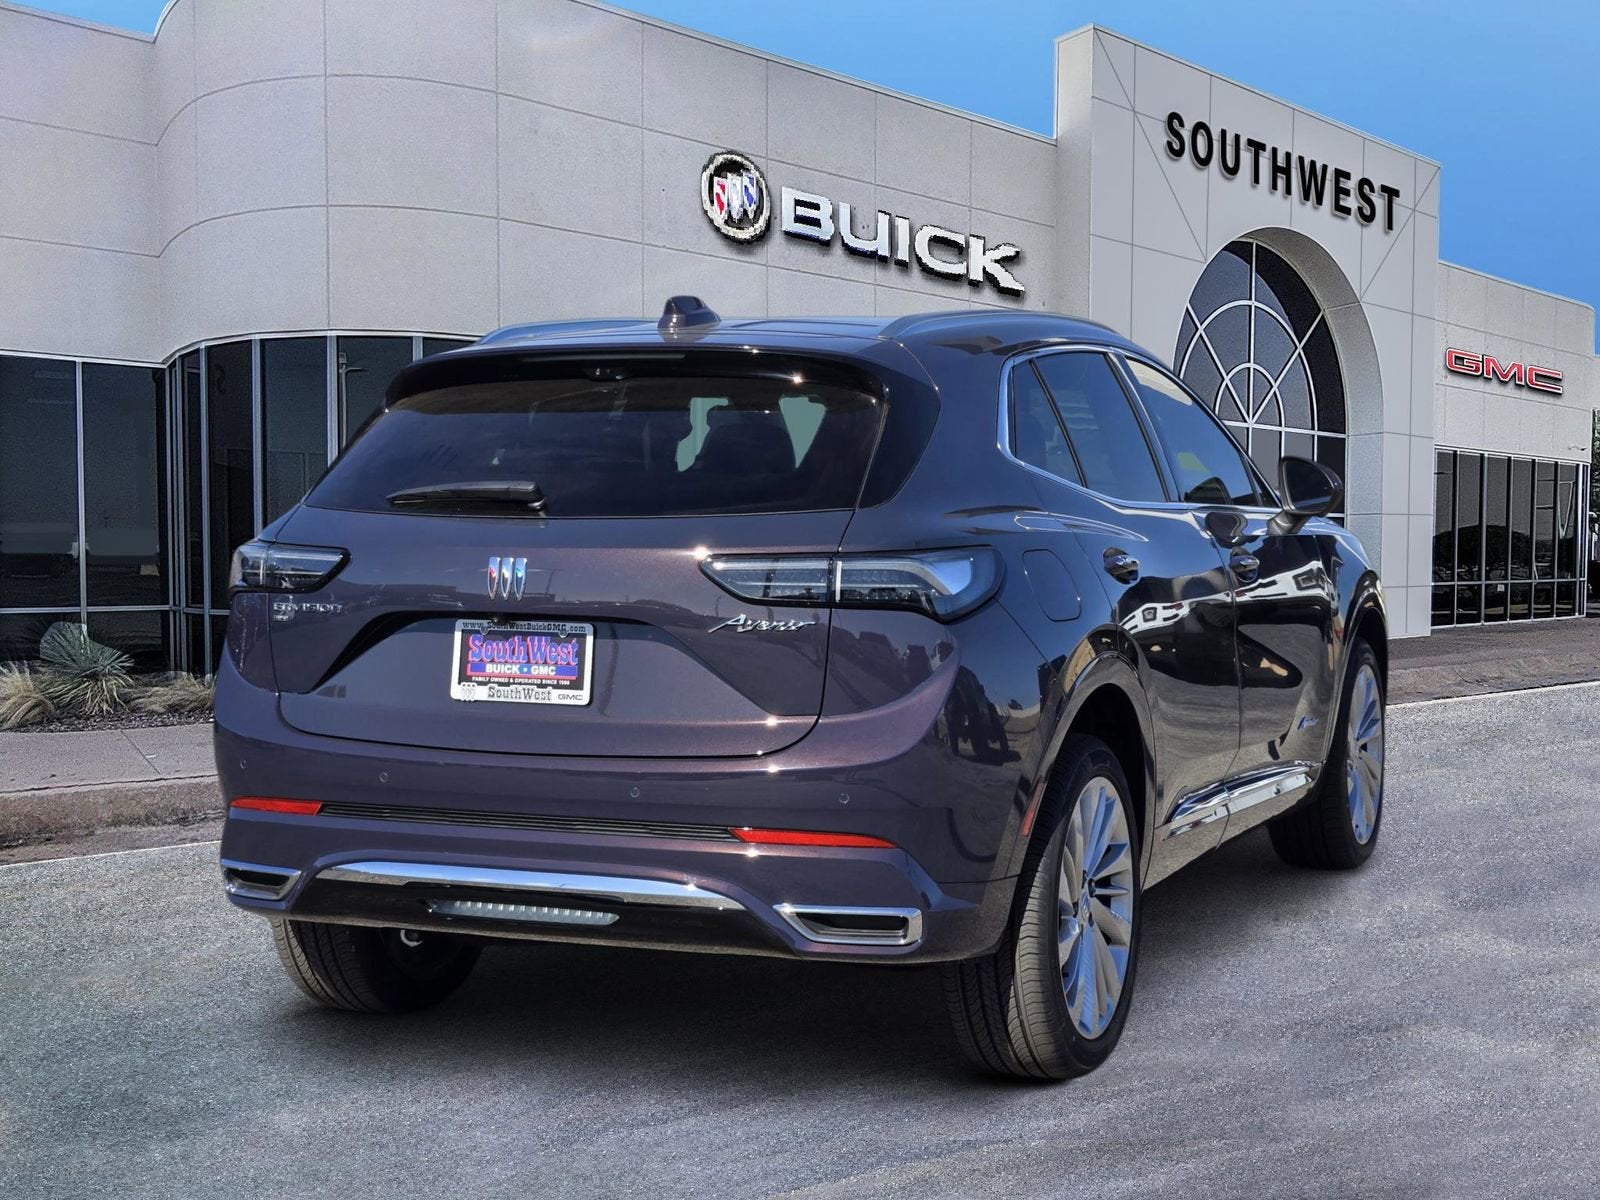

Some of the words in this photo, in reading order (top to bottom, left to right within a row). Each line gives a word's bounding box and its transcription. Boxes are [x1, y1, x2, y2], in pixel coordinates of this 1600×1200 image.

[1166, 111, 1400, 231] SOUTHWEST
[781, 187, 1026, 296] BUICK
[1446, 347, 1563, 395] GMC
[707, 613, 816, 633] Avenir
[468, 634, 580, 666] SouthWest
[485, 664, 520, 675] BUICK
[530, 666, 557, 676] GMC
[487, 686, 552, 701] SouthWest
[558, 693, 583, 701] GMC
